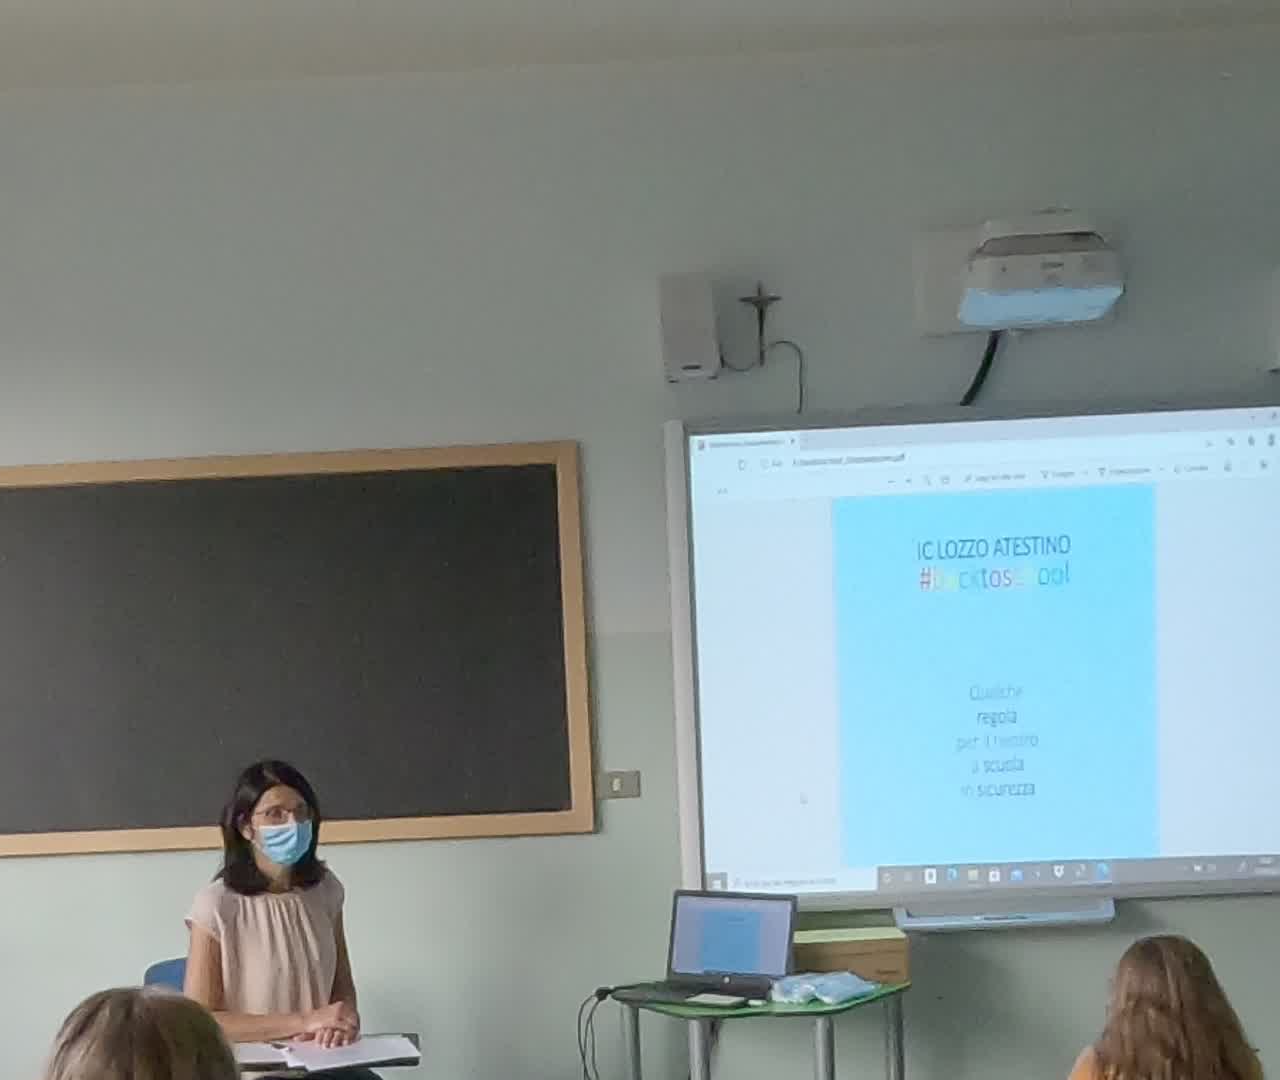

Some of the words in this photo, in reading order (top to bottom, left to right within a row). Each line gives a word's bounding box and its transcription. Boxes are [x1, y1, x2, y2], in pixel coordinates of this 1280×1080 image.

[917, 540, 933, 560] IC
[937, 538, 989, 560] LOZZO
[993, 534, 1071, 557] ATESTINO
